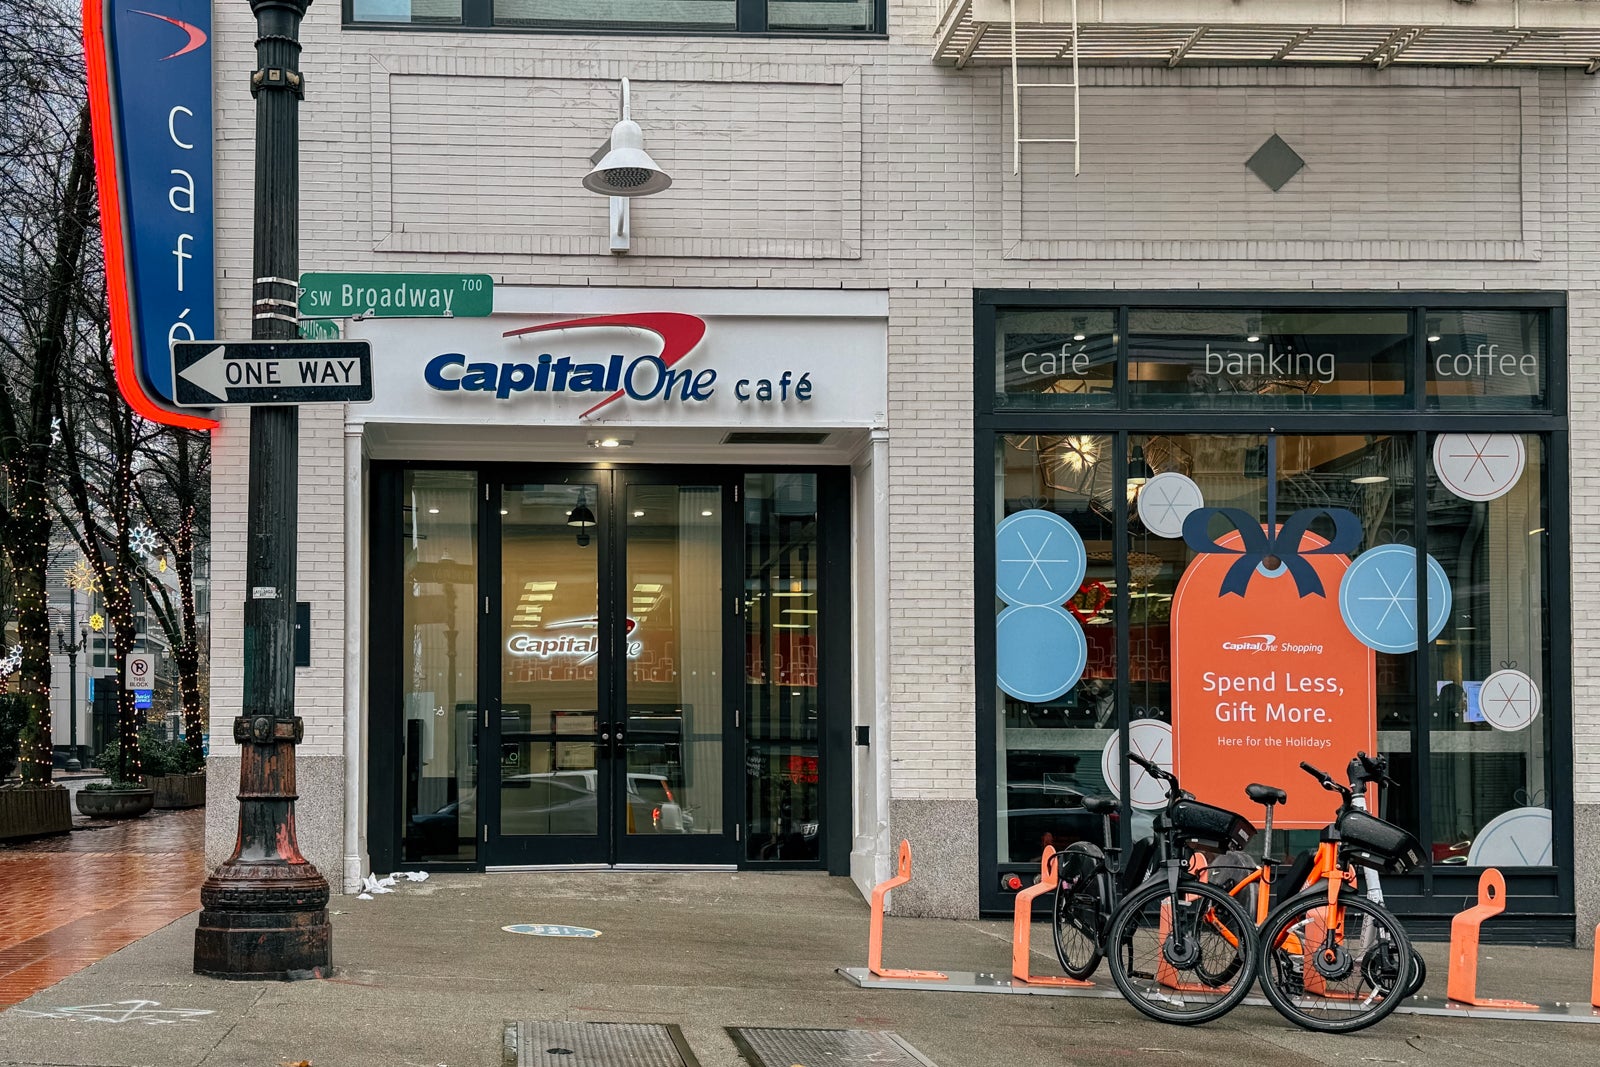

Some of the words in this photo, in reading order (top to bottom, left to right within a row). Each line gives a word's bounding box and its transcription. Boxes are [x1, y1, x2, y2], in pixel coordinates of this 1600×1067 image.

[310, 290, 332, 306] SW
[341, 282, 454, 310] Broadway
[461, 279, 483, 292] 700
[225, 361, 281, 385] ONE
[299, 360, 356, 384] WAY
[1021, 342, 1090, 376] café
[1205, 343, 1335, 383] banking
[1435, 344, 1537, 377] coffee
[734, 371, 812, 401] café
[1281, 642, 1323, 654] Shopping
[1202, 671, 1276, 696] Spend
[1286, 672, 1344, 696] Less,
[1215, 701, 1256, 723] Gift
[1266, 703, 1333, 723] More.
[1217, 736, 1243, 746] Here
[1246, 736, 1261, 747] for
[1264, 736, 1282, 746] the
[1285, 736, 1332, 748] Holidays
